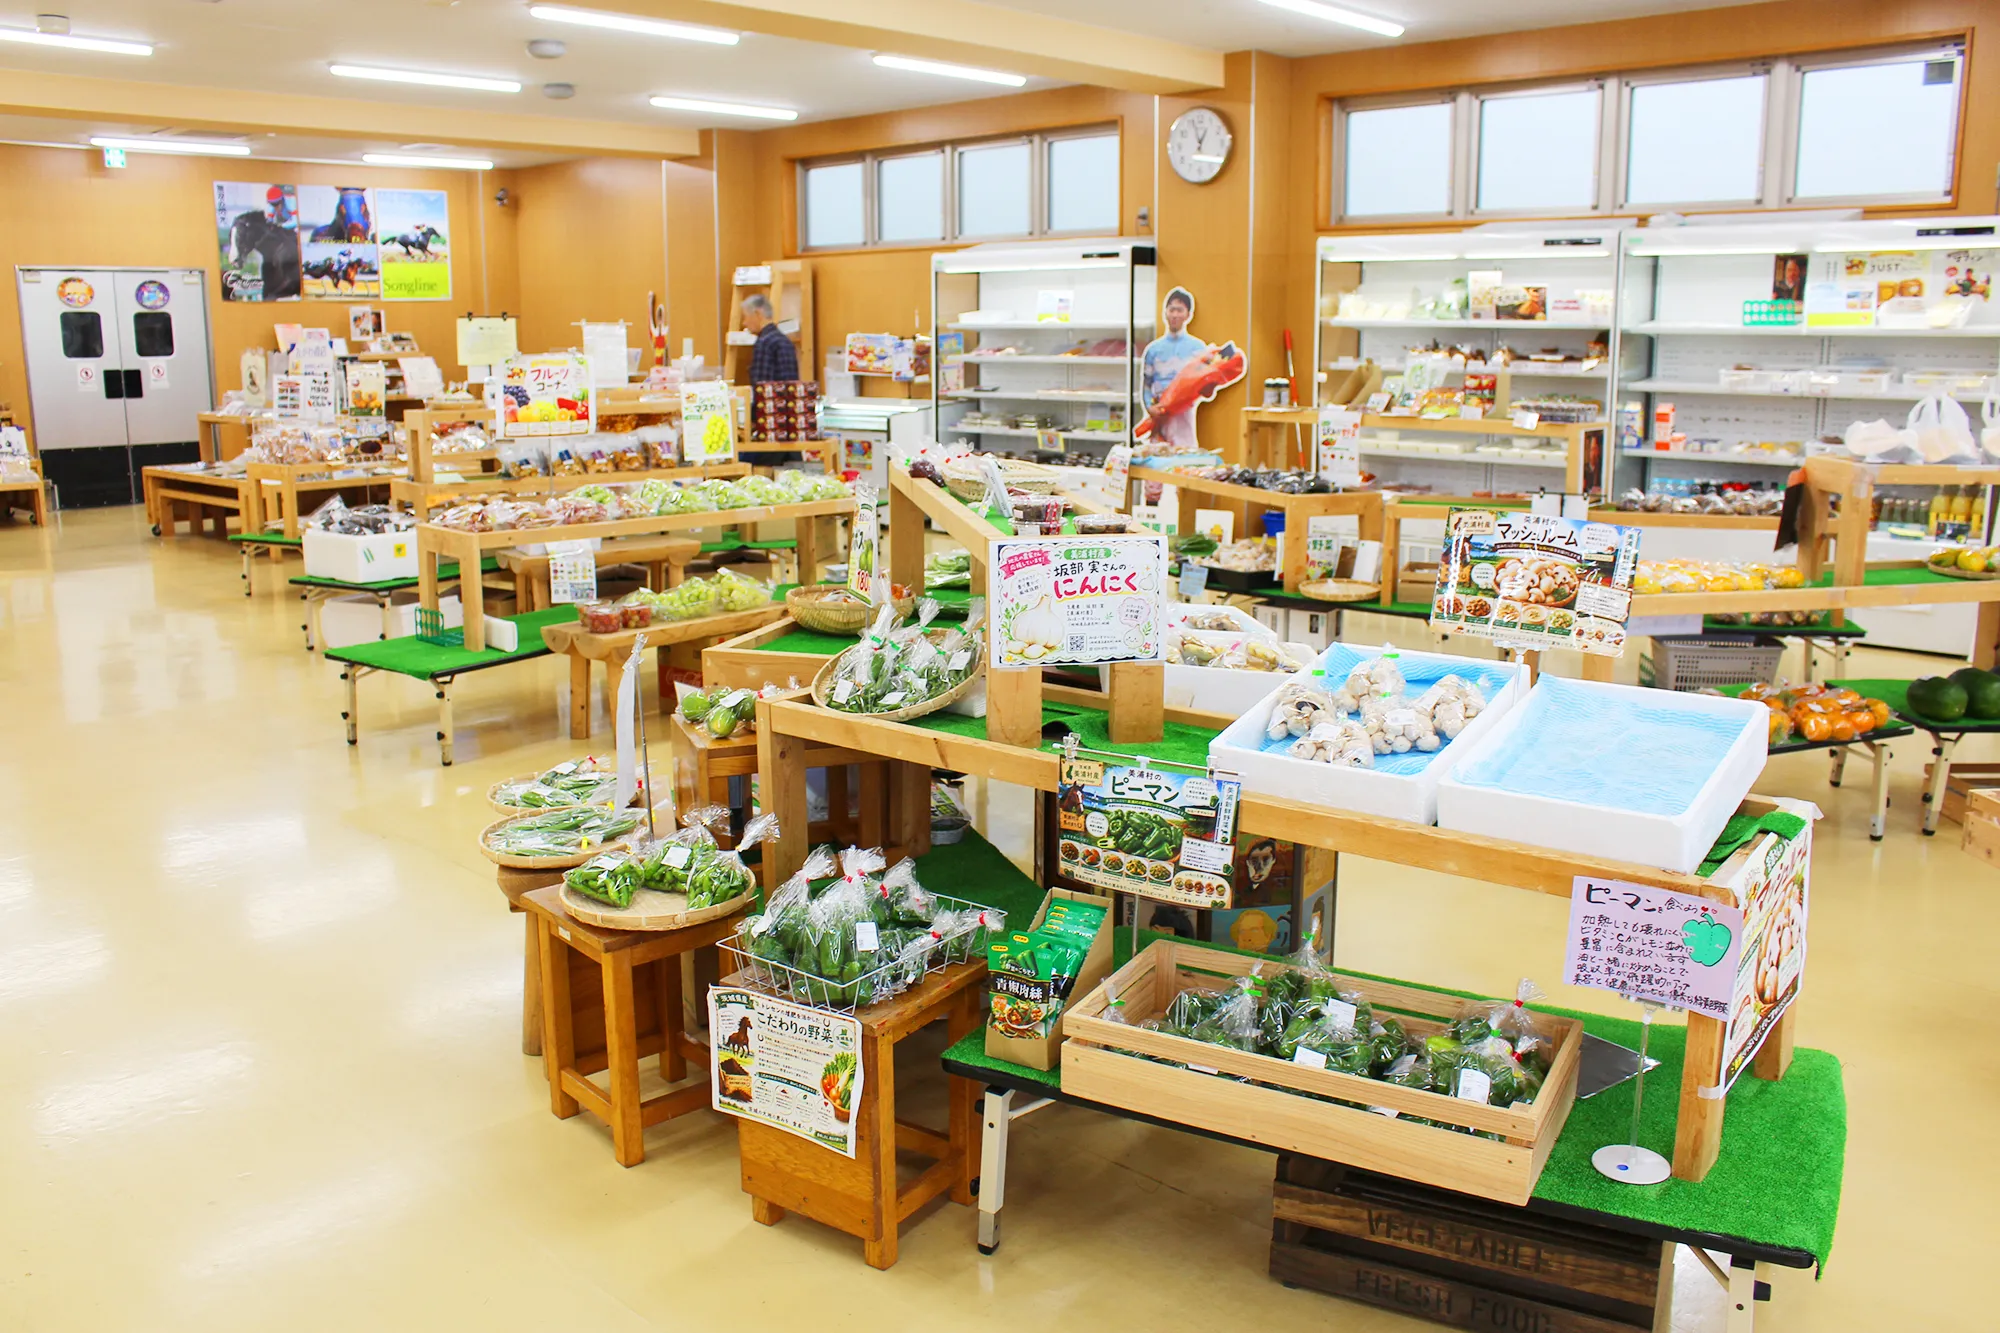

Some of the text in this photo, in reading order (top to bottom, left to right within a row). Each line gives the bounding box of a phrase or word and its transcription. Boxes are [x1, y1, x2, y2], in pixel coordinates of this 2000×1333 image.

[383, 277, 437, 294] Songline
[530, 368, 570, 382] フルーツ
[536, 381, 568, 392] コーナー
[1497, 523, 1579, 547] マッシュルーム
[1053, 561, 1127, 577] 坂部 実さんの
[1053, 571, 1138, 599] にんにく
[1073, 770, 1100, 779] 美浦村産
[1128, 768, 1162, 782] 美浦村の
[1111, 775, 1180, 803] ピーマン
[1581, 914, 1689, 938] 加熱しても壊れにくい
[1579, 937, 1690, 965] 豊富に含まれています
[1577, 953, 1689, 977] 油と一緒に炒めることで
[995, 977, 1043, 1000] 青椒肉絲
[757, 1011, 834, 1043] こだわりの野菜
[1367, 1209, 1551, 1273] VEGETABLE
